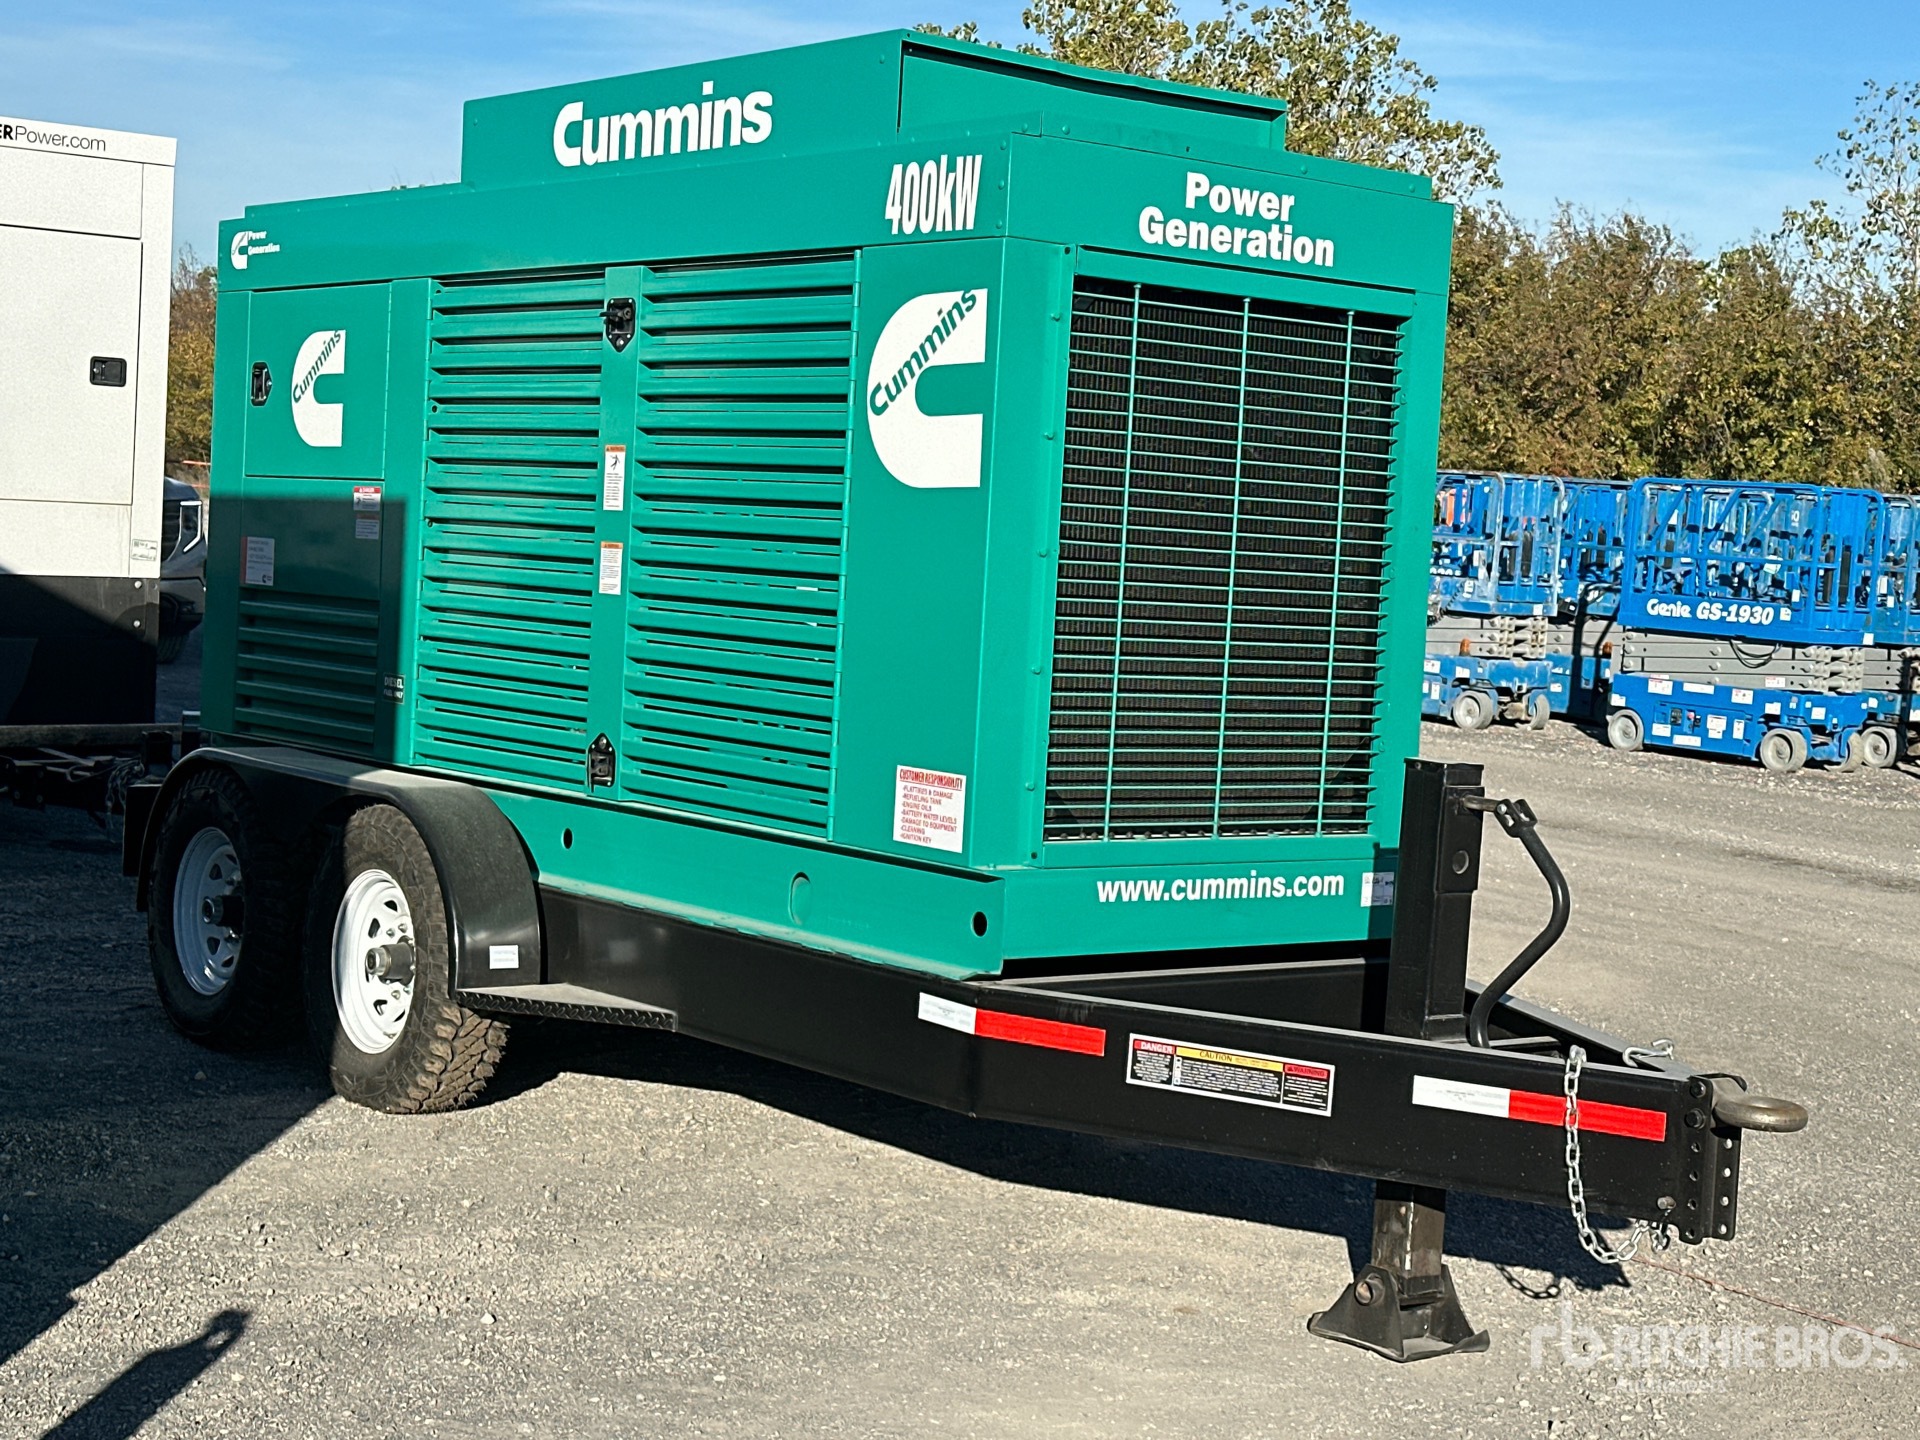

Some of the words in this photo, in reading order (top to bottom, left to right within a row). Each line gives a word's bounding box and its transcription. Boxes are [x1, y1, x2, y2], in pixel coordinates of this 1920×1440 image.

[553, 81, 773, 167] Cummins
[885, 154, 983, 235] 400kW
[1185, 171, 1295, 222] Power
[1139, 206, 1334, 267] Generation
[293, 330, 341, 403] Cummins
[869, 290, 978, 417] Cummins
[1647, 598, 1692, 618] Genie
[1696, 601, 1774, 625] GS-1930
[900, 768, 925, 782] CUSTOMER
[925, 774, 963, 789] RESPONSIBILITY
[1097, 870, 1344, 902] www.cummins.com
[1140, 1041, 1172, 1055] DANGER
[1199, 1051, 1233, 1063] CAUTION
